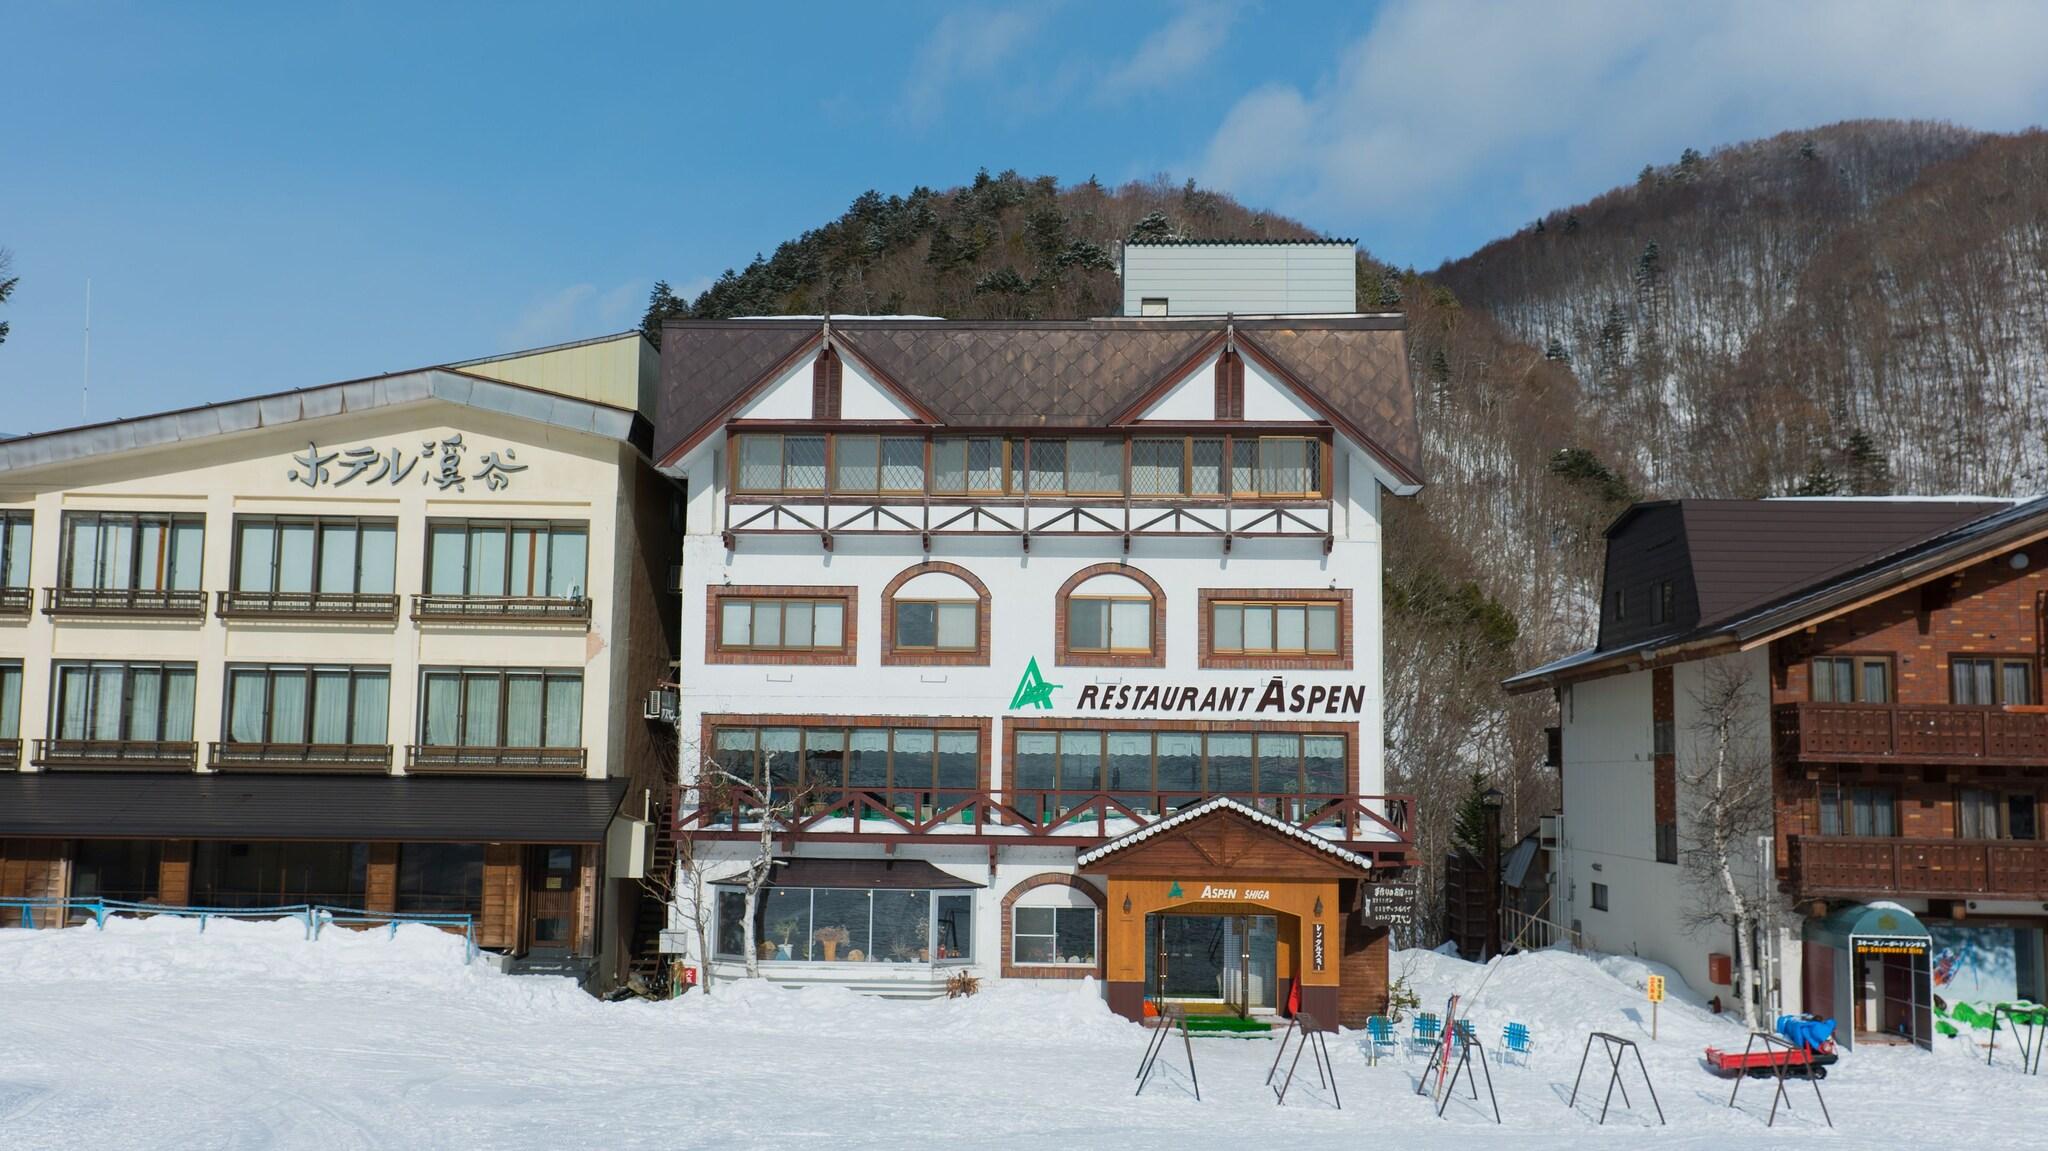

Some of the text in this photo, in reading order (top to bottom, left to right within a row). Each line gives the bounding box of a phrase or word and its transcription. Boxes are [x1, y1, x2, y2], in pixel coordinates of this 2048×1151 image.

[1077, 685, 1256, 712] RESTAURANT
[1200, 885, 1270, 900] ASPEN SHIGA
[1315, 924, 1323, 971] レンタルスキー
